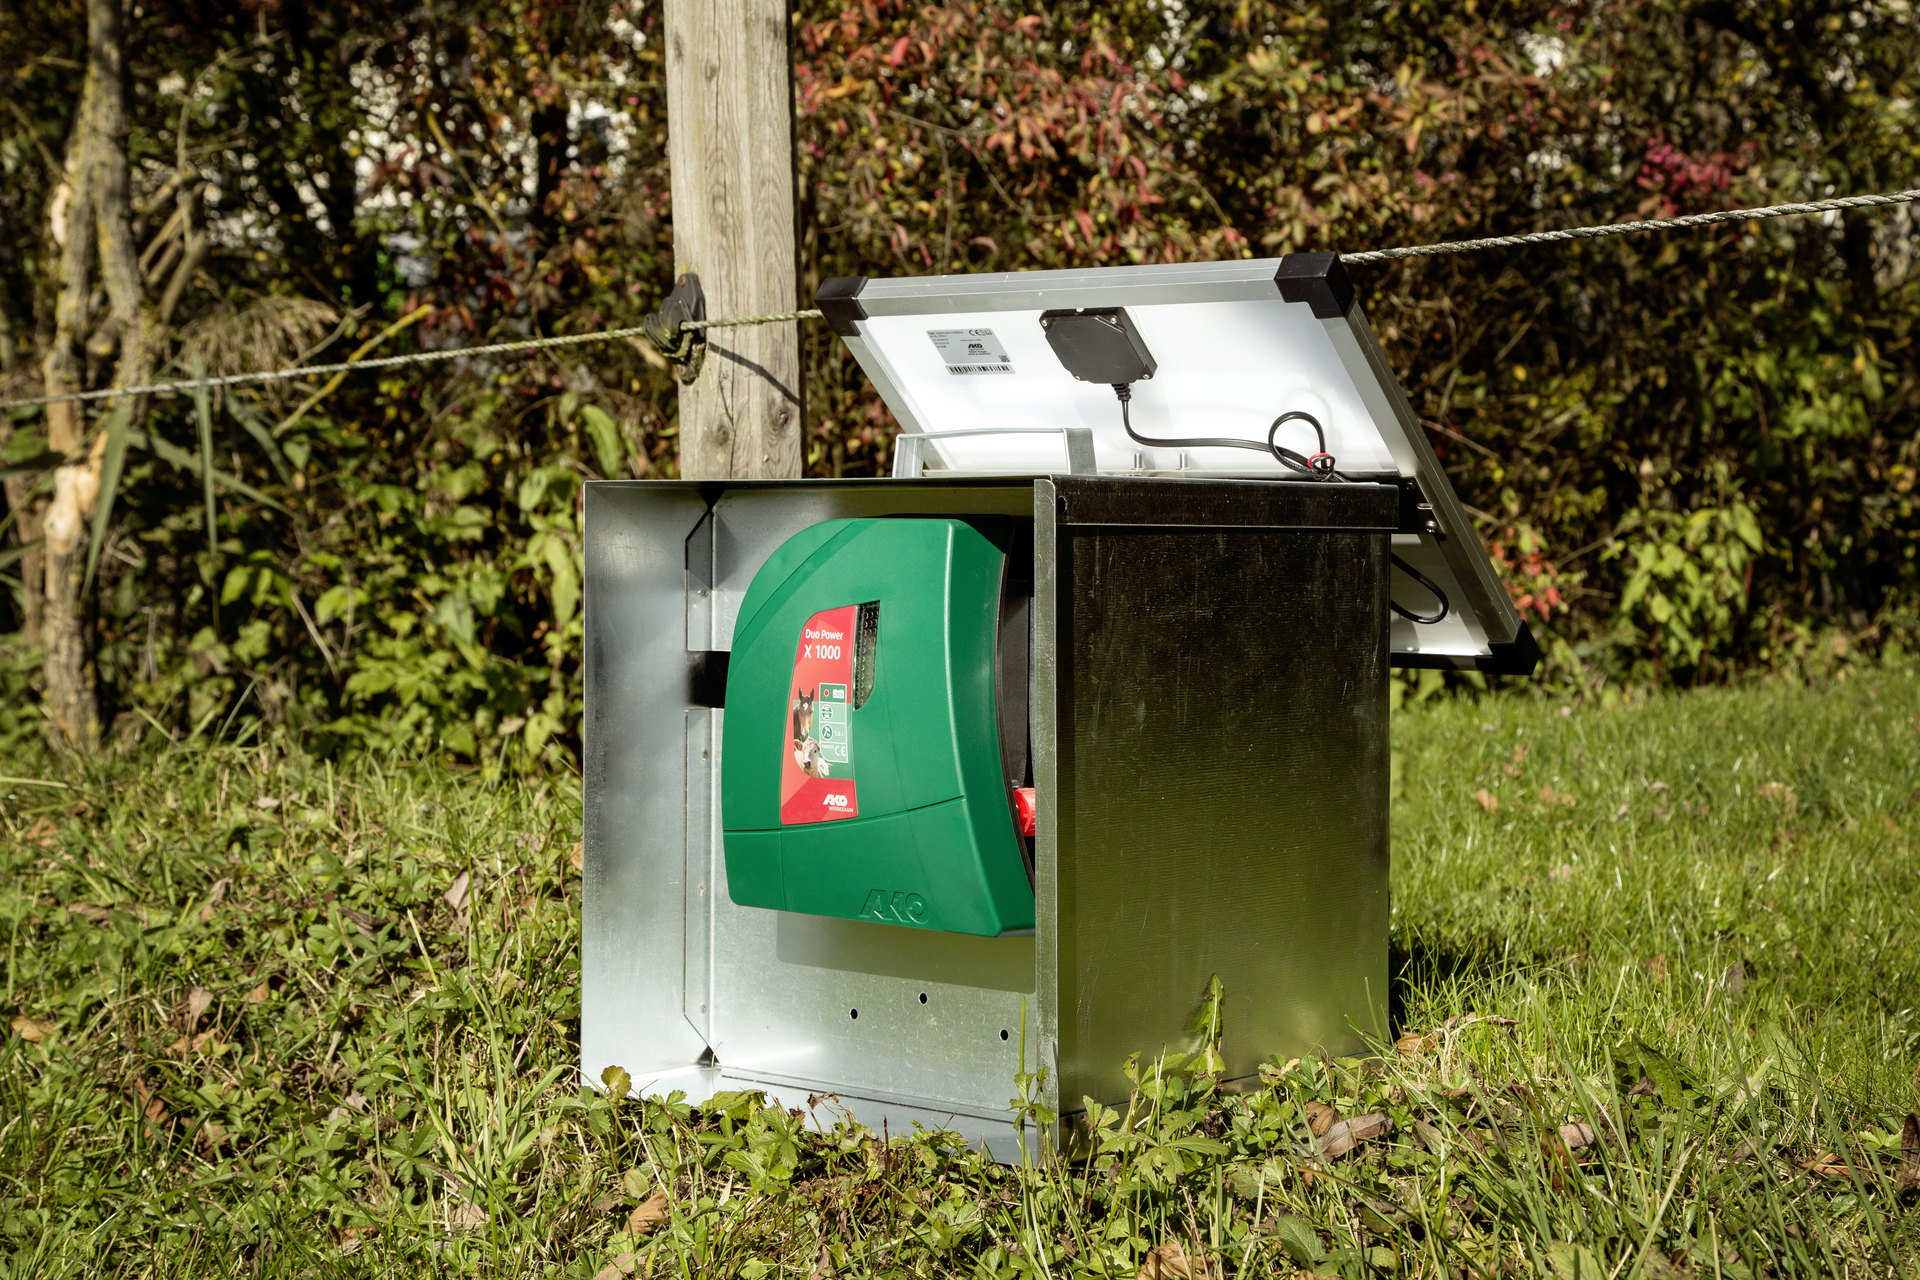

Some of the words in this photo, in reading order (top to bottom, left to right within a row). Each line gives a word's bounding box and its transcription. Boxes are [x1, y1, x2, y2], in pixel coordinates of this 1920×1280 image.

[805, 629, 820, 639] Duo
[821, 630, 844, 640] Power
[804, 644, 812, 659] X
[815, 645, 841, 660] 1000
[823, 794, 848, 807] AKO
[859, 888, 930, 925] AKO
